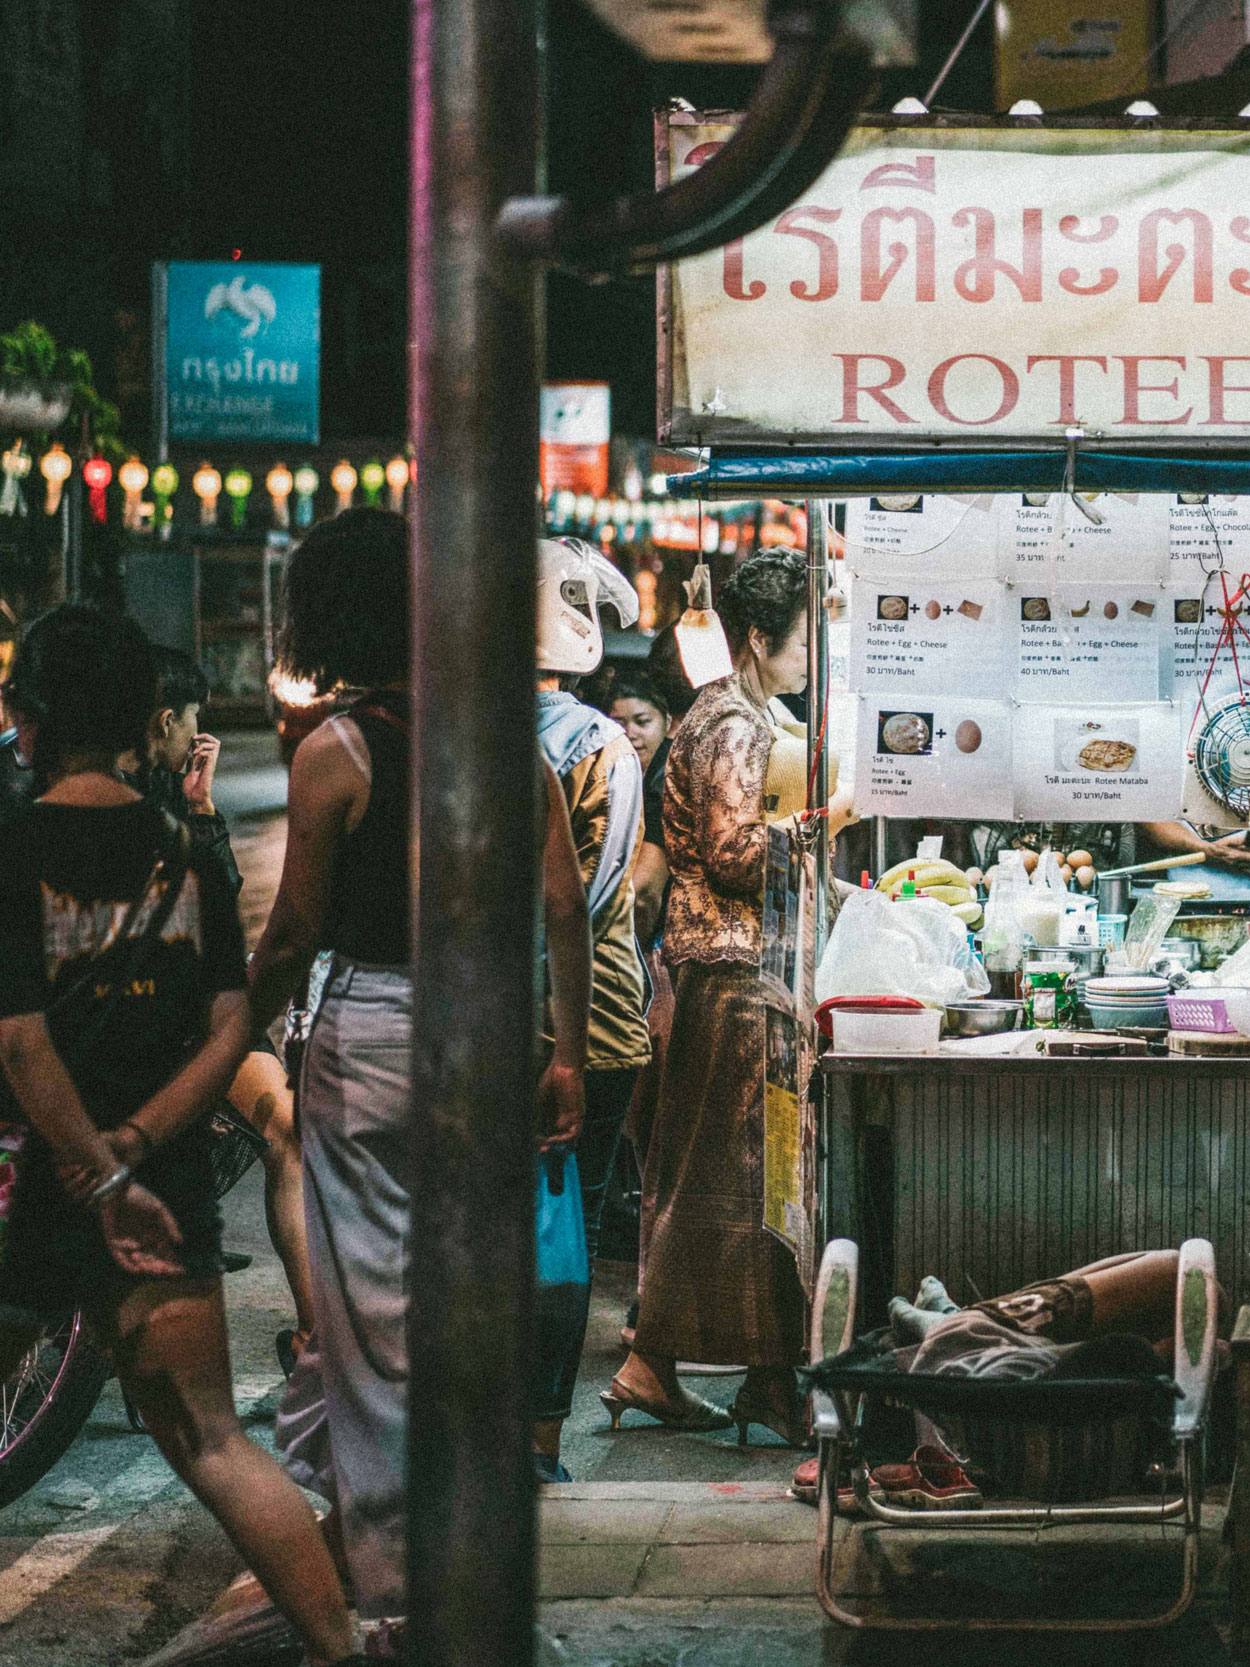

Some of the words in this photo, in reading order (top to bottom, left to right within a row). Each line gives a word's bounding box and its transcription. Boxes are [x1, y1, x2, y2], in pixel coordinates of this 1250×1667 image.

[1016, 525, 1039, 533] Rotee
[1084, 526, 1112, 534] Cheese
[1201, 524, 1215, 533] Egg
[1016, 553, 1026, 562] 35
[1170, 552, 1180, 560] 25
[867, 638, 890, 647] Rotee
[898, 640, 912, 649] Egg
[920, 640, 948, 649] Cheese
[1021, 639, 1044, 647] Rotee
[1089, 640, 1102, 649] Egg
[1111, 640, 1139, 648] Cheese
[1174, 642, 1197, 650] Rotee
[877, 667, 915, 676] บาท/Baht
[1021, 668, 1031, 676] 40
[1032, 668, 1070, 676] บาท/Baht
[1174, 669, 1184, 677] 30
[1095, 777, 1118, 785] Rotee
[1120, 777, 1149, 785] Mataba
[1084, 792, 1122, 800] บาท/Baht
